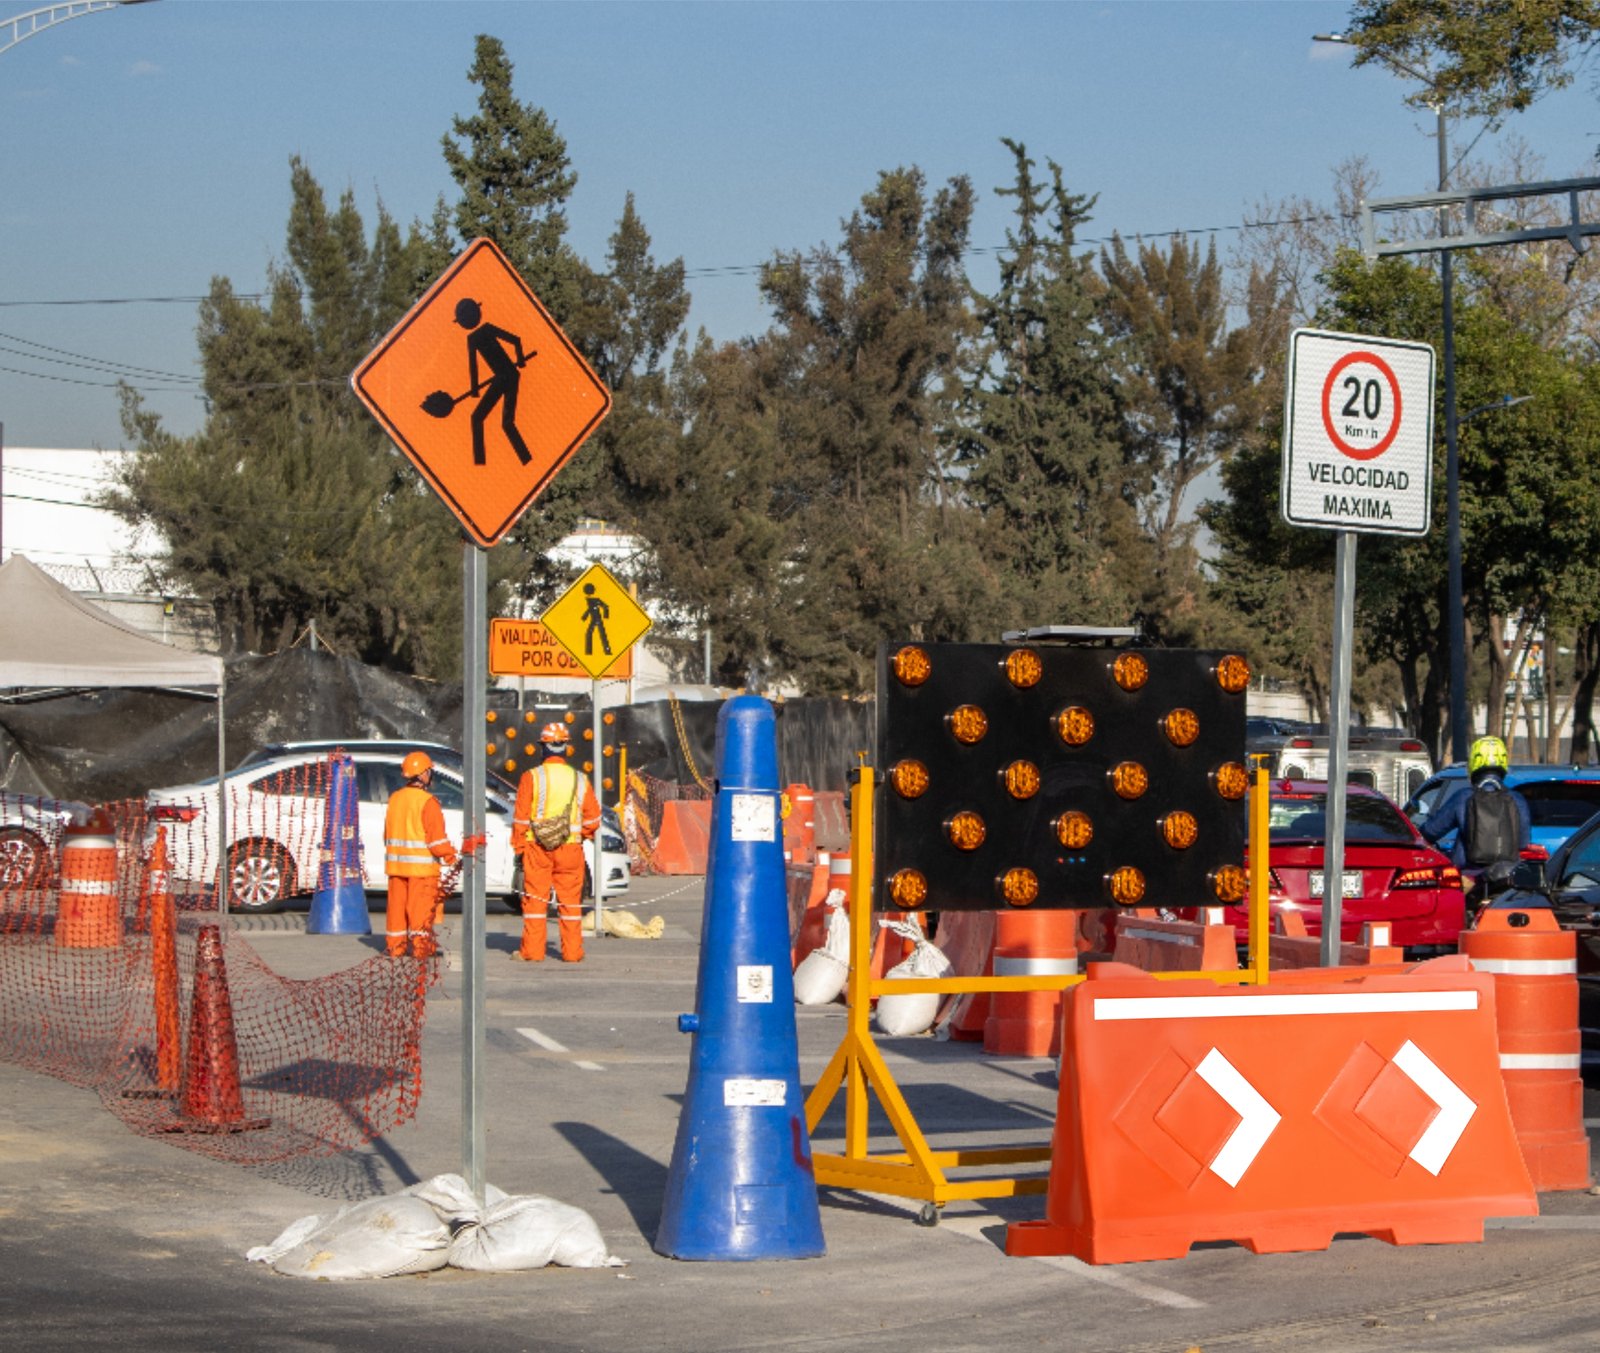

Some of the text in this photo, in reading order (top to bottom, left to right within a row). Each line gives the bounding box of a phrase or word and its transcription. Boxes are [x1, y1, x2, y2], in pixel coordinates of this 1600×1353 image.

[1341, 376, 1382, 420] 20
[1308, 462, 1409, 490] VELOCIDAD
[1323, 494, 1393, 520] MAXIMA
[521, 650, 579, 669] POR OB
